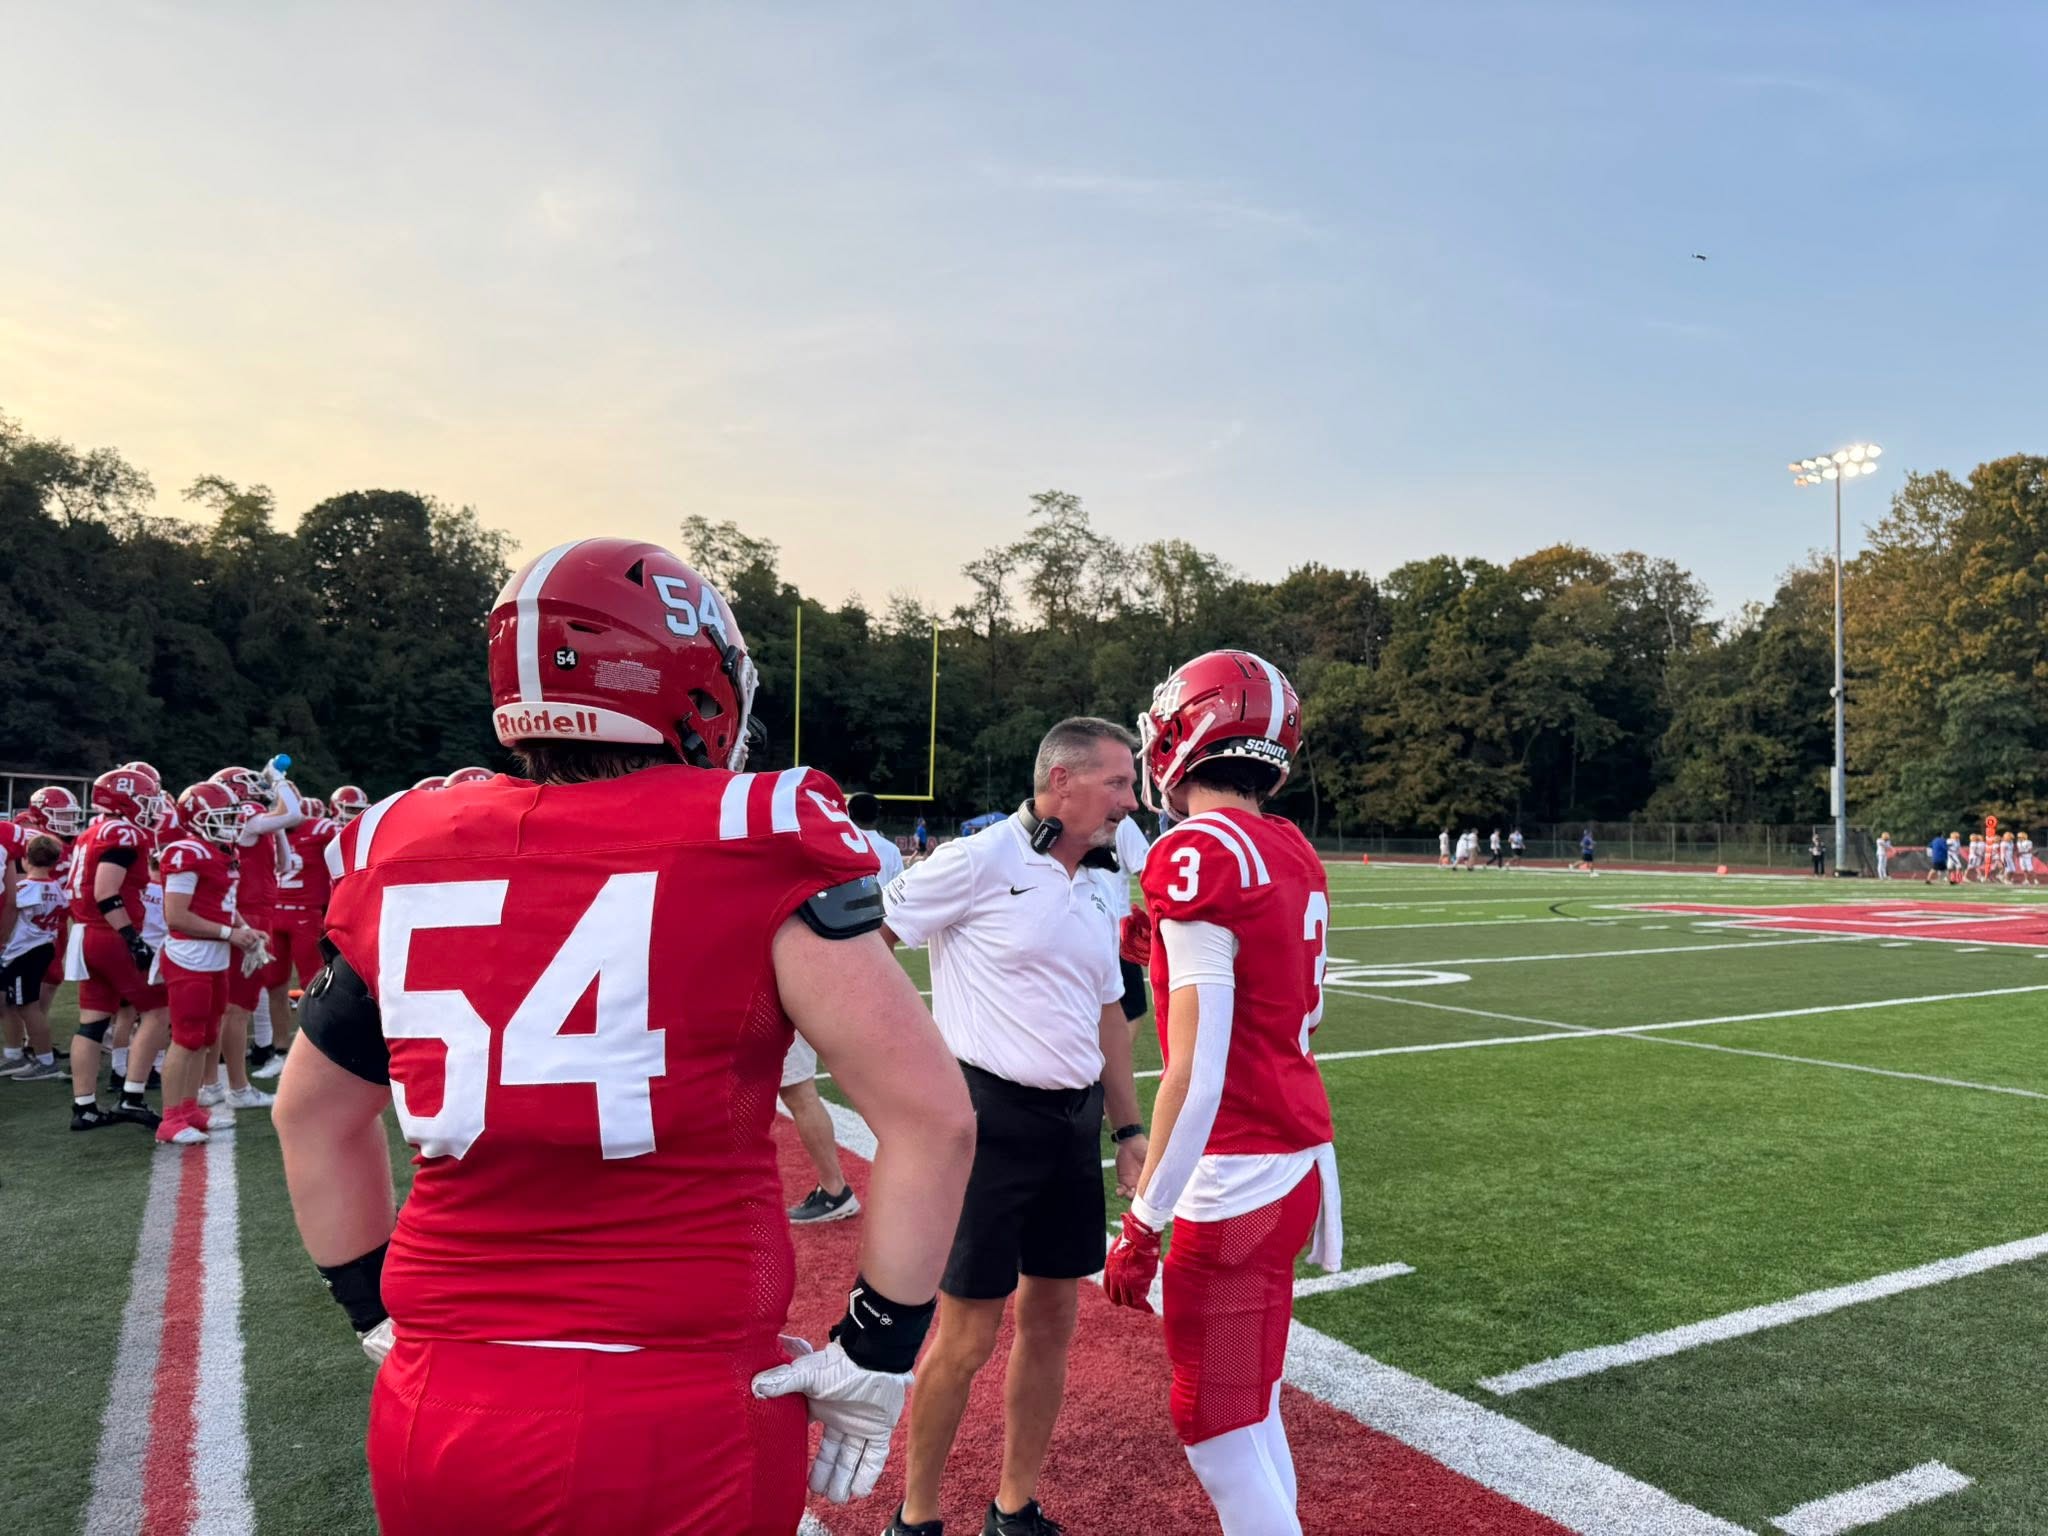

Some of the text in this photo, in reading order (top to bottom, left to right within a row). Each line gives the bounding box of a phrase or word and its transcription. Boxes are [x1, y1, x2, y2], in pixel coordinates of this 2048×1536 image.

[652, 574, 728, 646] 54
[556, 651, 576, 665] 54
[496, 710, 598, 735] Riddell
[1245, 739, 1288, 759] schutt
[116, 778, 135, 794] 21
[185, 796, 194, 812] 4
[117, 829, 138, 846] 21
[170, 851, 183, 869] 4
[1167, 847, 1202, 902] 3
[378, 871, 667, 1160] 54
